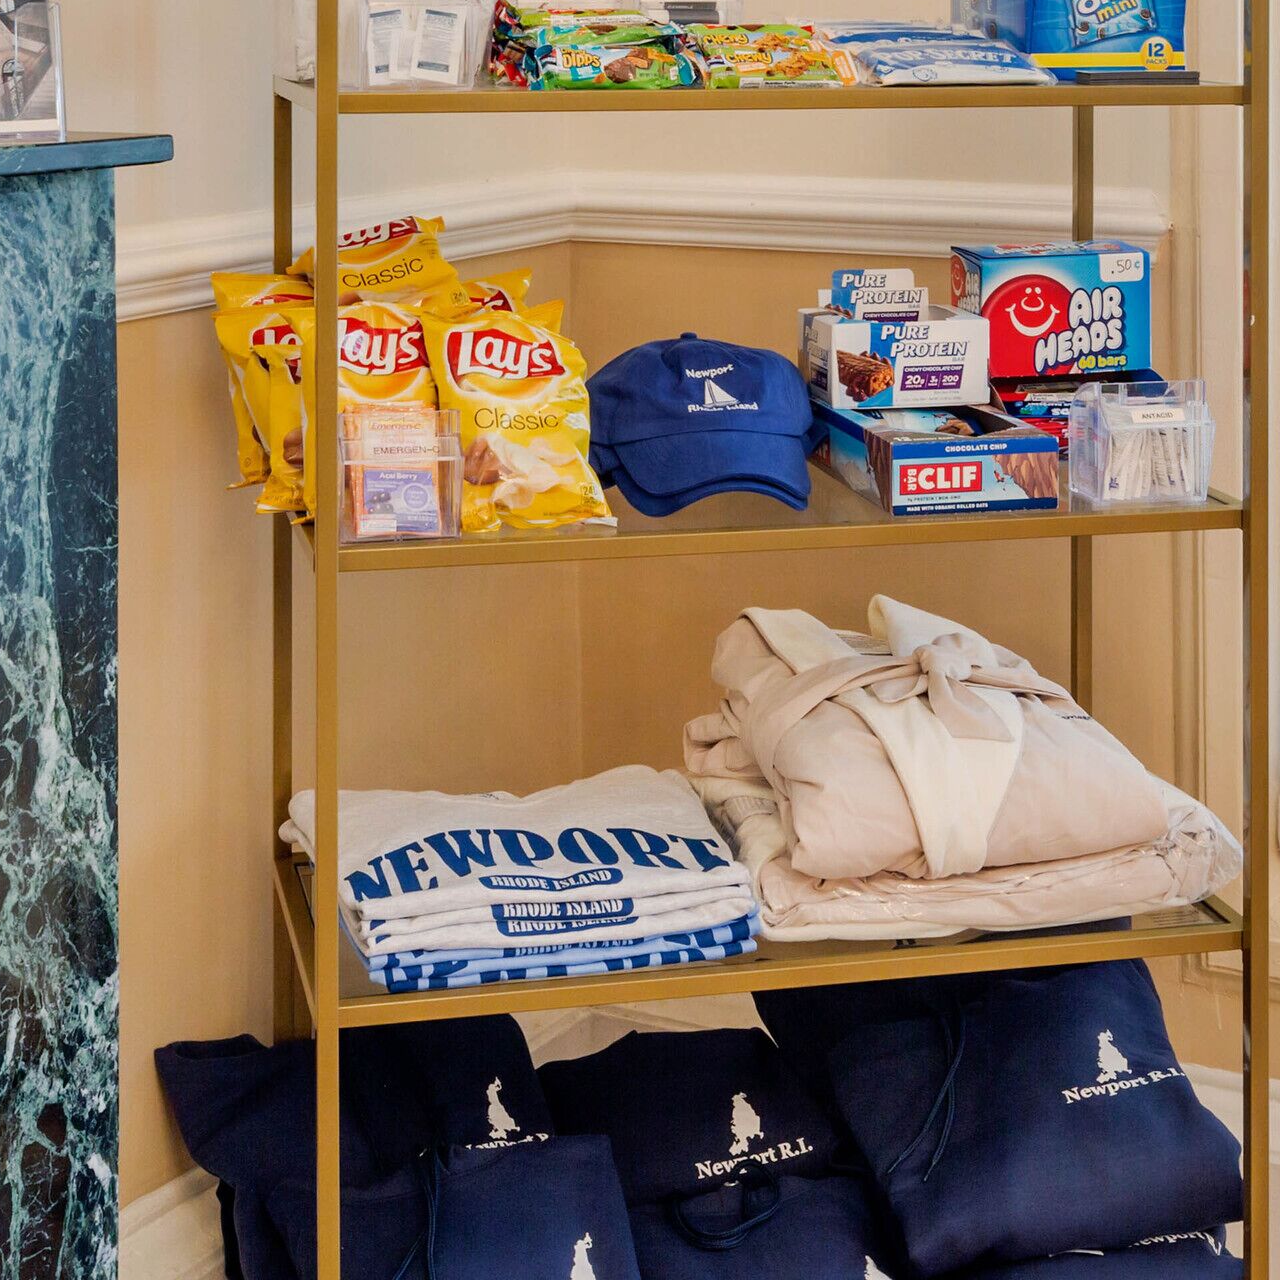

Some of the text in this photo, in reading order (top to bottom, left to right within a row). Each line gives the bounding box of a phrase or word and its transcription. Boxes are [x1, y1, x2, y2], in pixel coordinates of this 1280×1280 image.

[1147, 42, 1164, 58] 12
[342, 258, 424, 288] Classic
[841, 274, 886, 288] PURE
[851, 290, 922, 304] PROTEIN
[1069, 286, 1123, 329] AIR
[881, 325, 929, 340] PURE
[890, 342, 967, 357] PROTEIN
[1035, 319, 1123, 372] HEADS
[457, 331, 553, 380] Lay's
[1098, 355, 1126, 367] bars
[685, 363, 734, 378] Newport
[474, 408, 558, 430] Classic
[373, 445, 440, 455] EMERGEN-C
[945, 443, 1007, 452] CHOCOLATE CHIP
[396, 471, 417, 480] Berry
[907, 466, 977, 491] BAR CLIF
[344, 827, 730, 903] NEWPORT
[490, 869, 613, 891] RHODE ISLAND
[504, 899, 623, 918] RHODE ISLAND
[1061, 1067, 1186, 1105] Newport R.I.
[695, 1137, 814, 1180] Newrt R.I.
